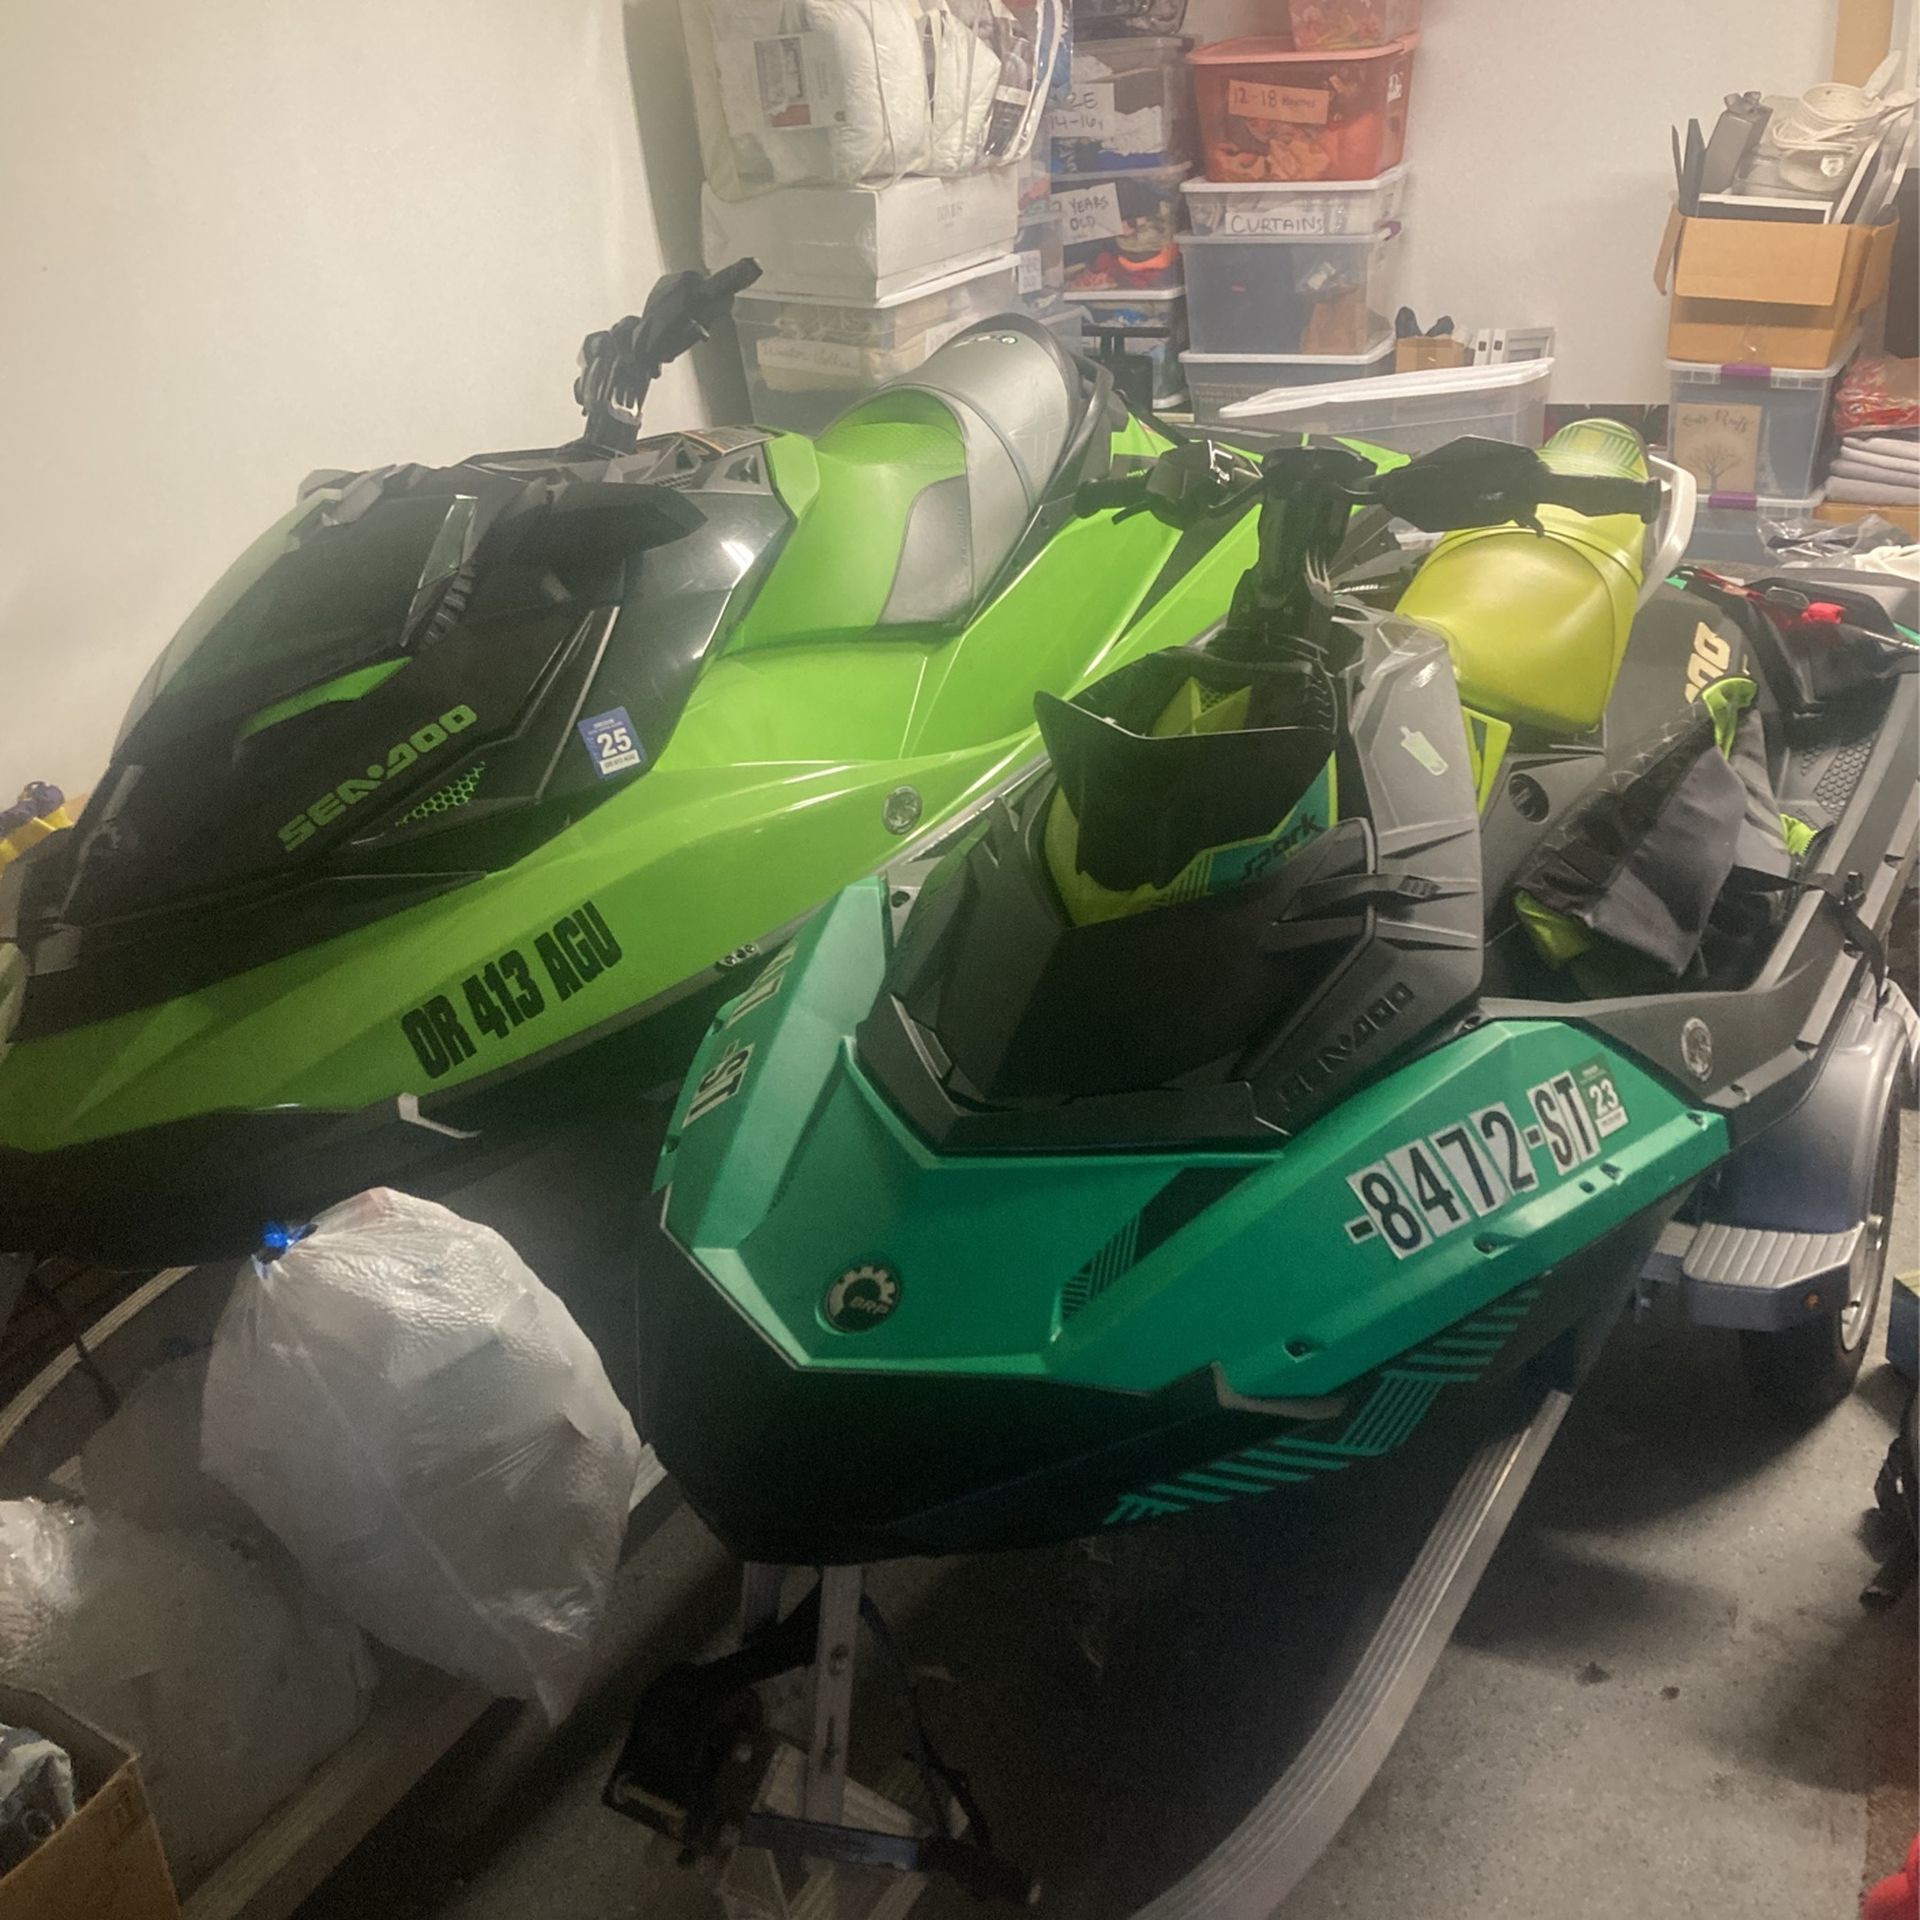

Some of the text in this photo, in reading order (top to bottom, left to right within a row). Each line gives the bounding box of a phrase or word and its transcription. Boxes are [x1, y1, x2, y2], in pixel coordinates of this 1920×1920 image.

[1230, 214, 1324, 233] CURTAINS
[596, 727, 632, 758] 25
[400, 899, 623, 1080] OR 413 AGU
[1588, 1078, 1620, 1118] 23
